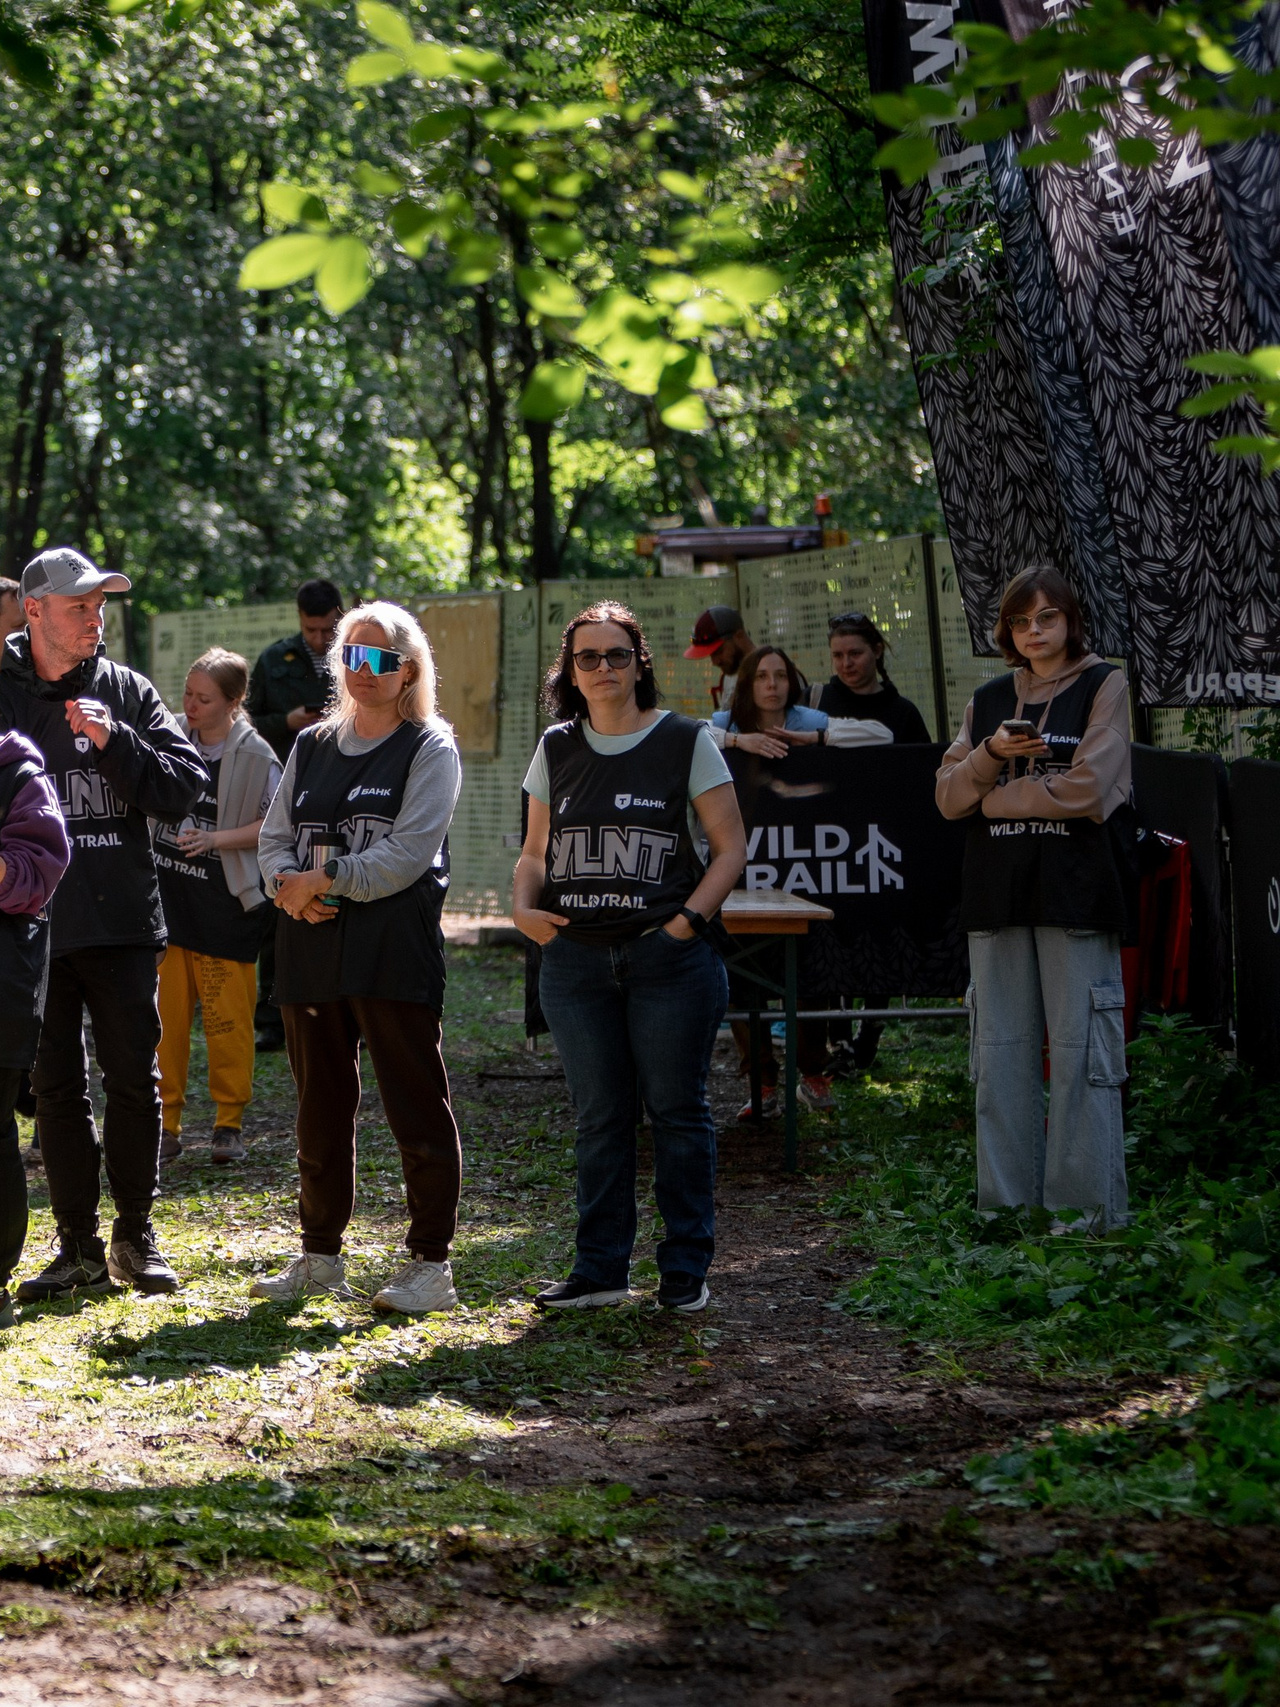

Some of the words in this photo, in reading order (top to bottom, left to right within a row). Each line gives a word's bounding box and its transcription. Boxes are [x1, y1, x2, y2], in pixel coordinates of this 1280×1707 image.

[361, 787, 392, 797] БАНК
[632, 798, 667, 810] БАНК
[989, 823, 1026, 837] WILD
[76, 832, 123, 848] TRAIL
[550, 825, 679, 885] VLNT
[173, 860, 209, 881] TRAIL
[741, 860, 866, 895] RAIL
[559, 893, 600, 909] WILD
[600, 893, 648, 910] TRAIL
